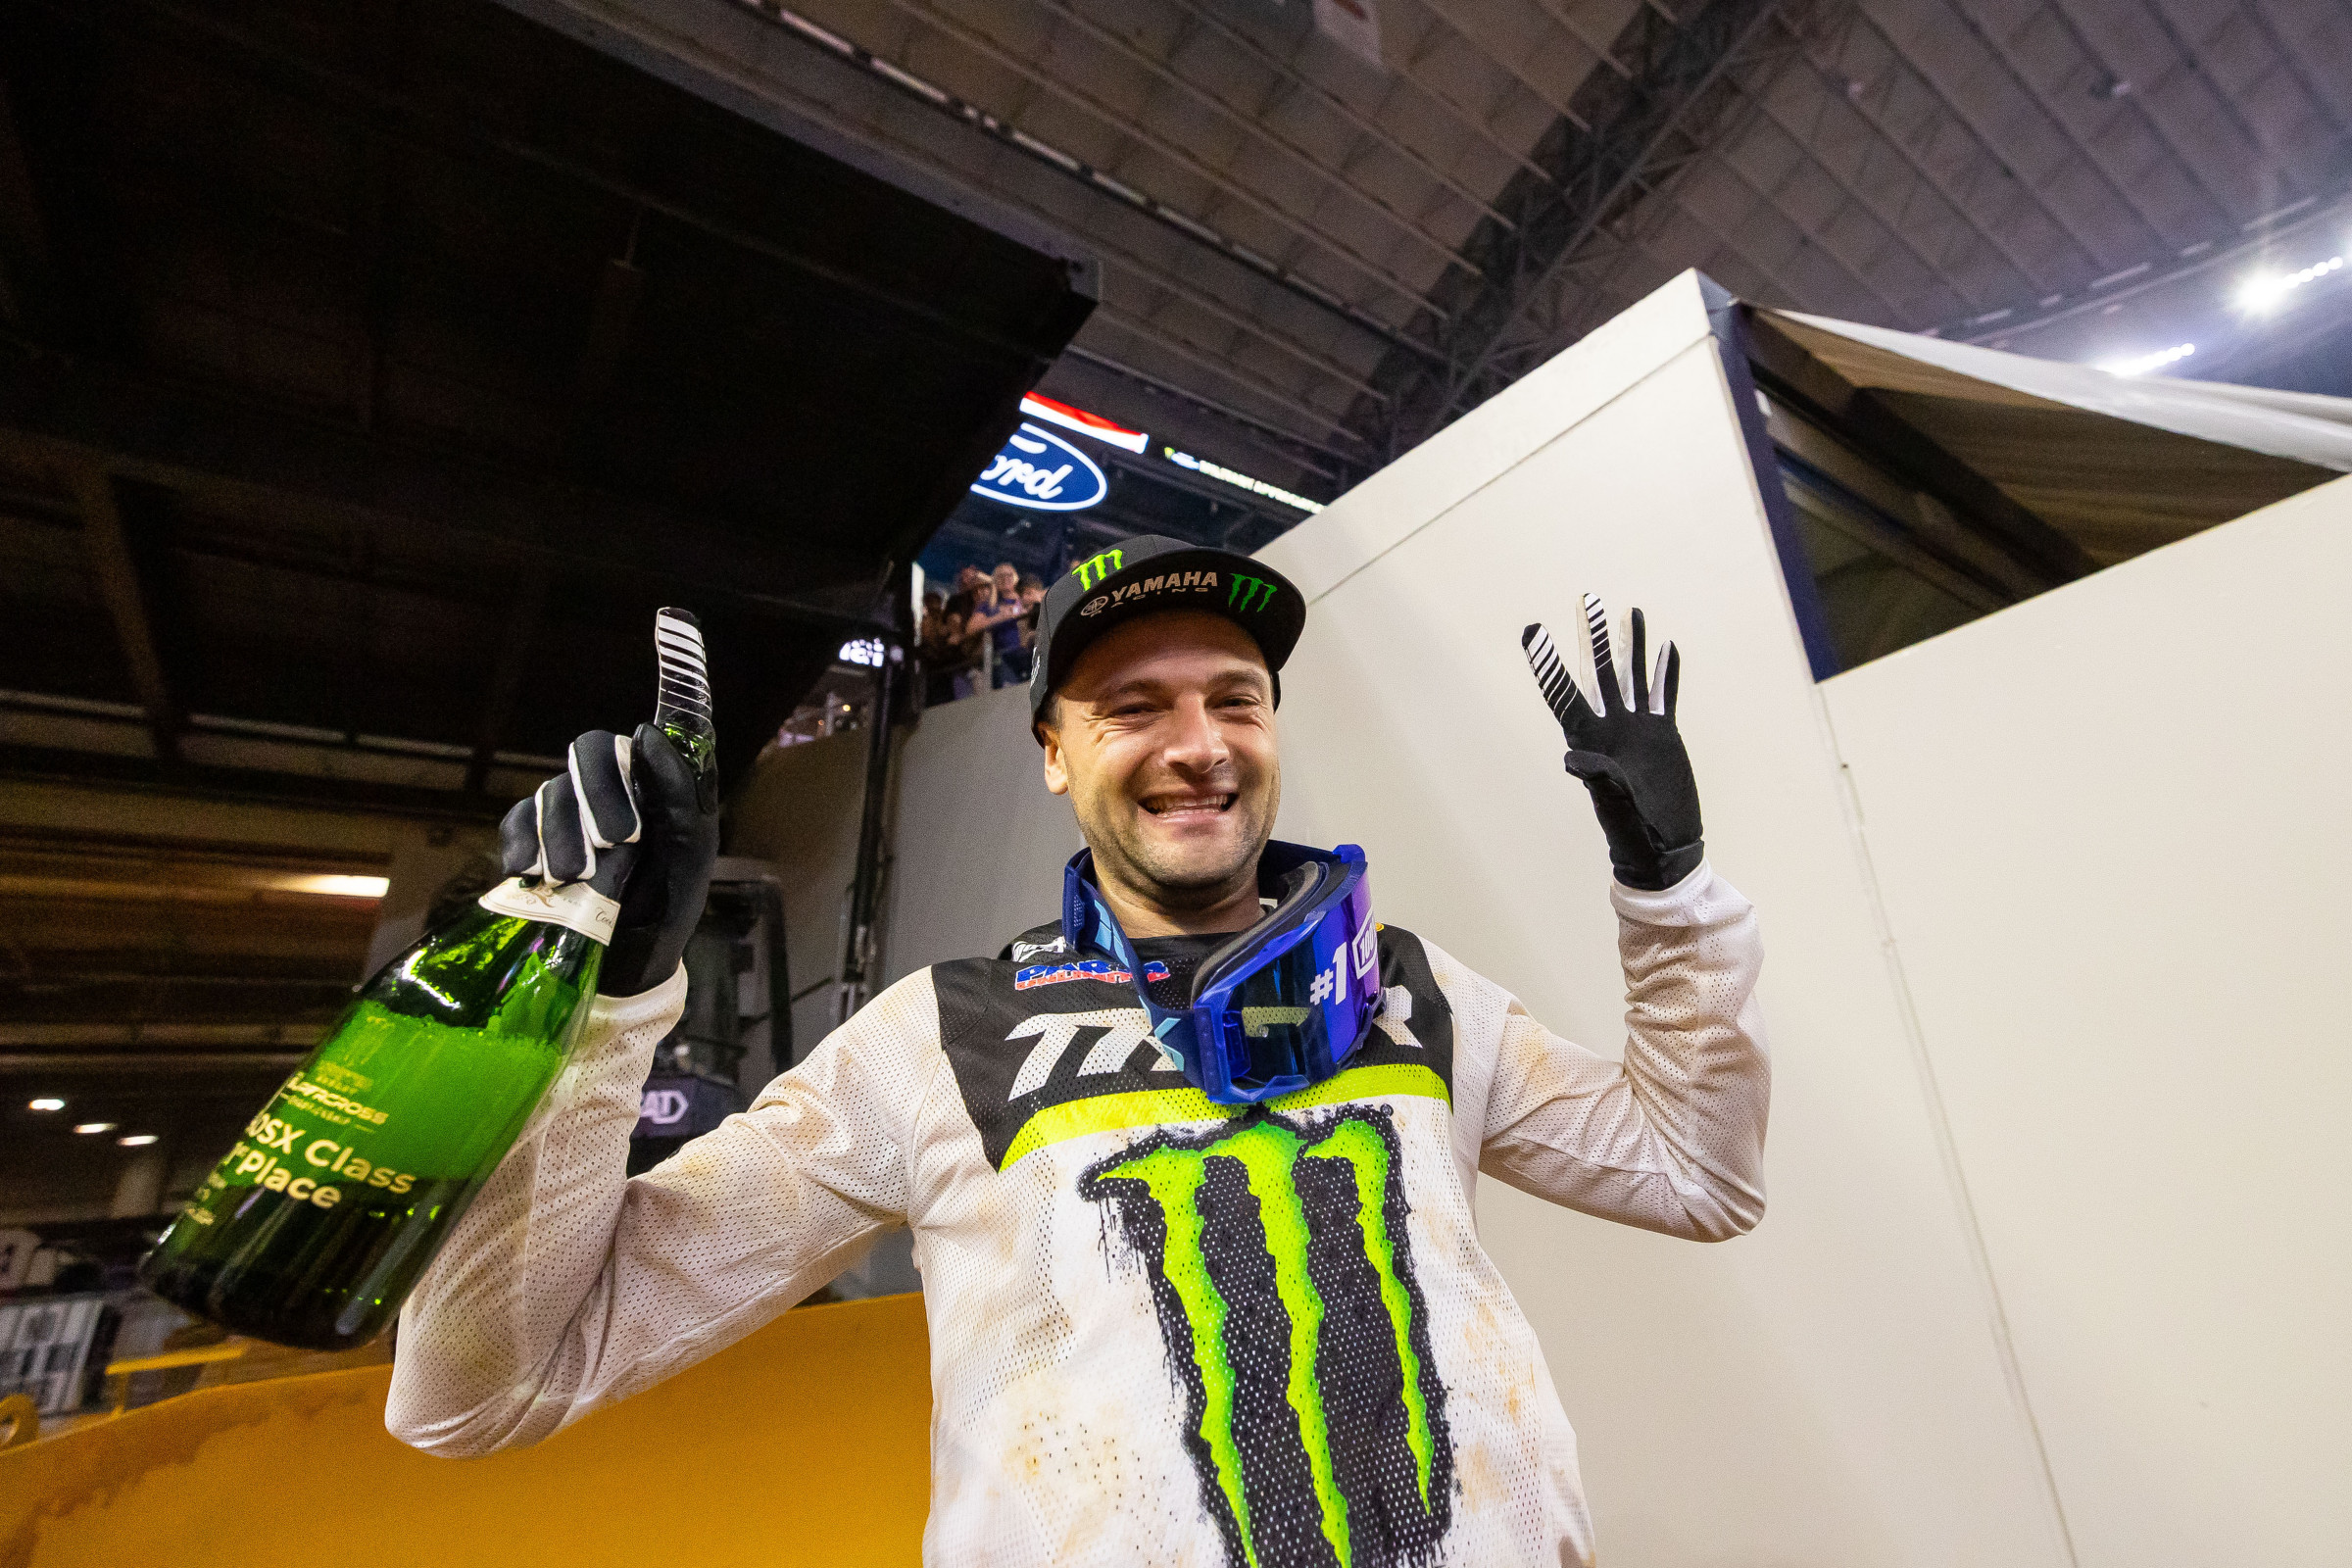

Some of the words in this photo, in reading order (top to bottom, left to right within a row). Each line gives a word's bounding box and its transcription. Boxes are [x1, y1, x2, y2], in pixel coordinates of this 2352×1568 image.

[1110, 570, 1218, 603] YAMAHA
[1015, 959, 1169, 983] PARS
[1309, 941, 1348, 1006] #1
[234, 1149, 342, 1209] Place
[304, 1139, 417, 1195] Class
